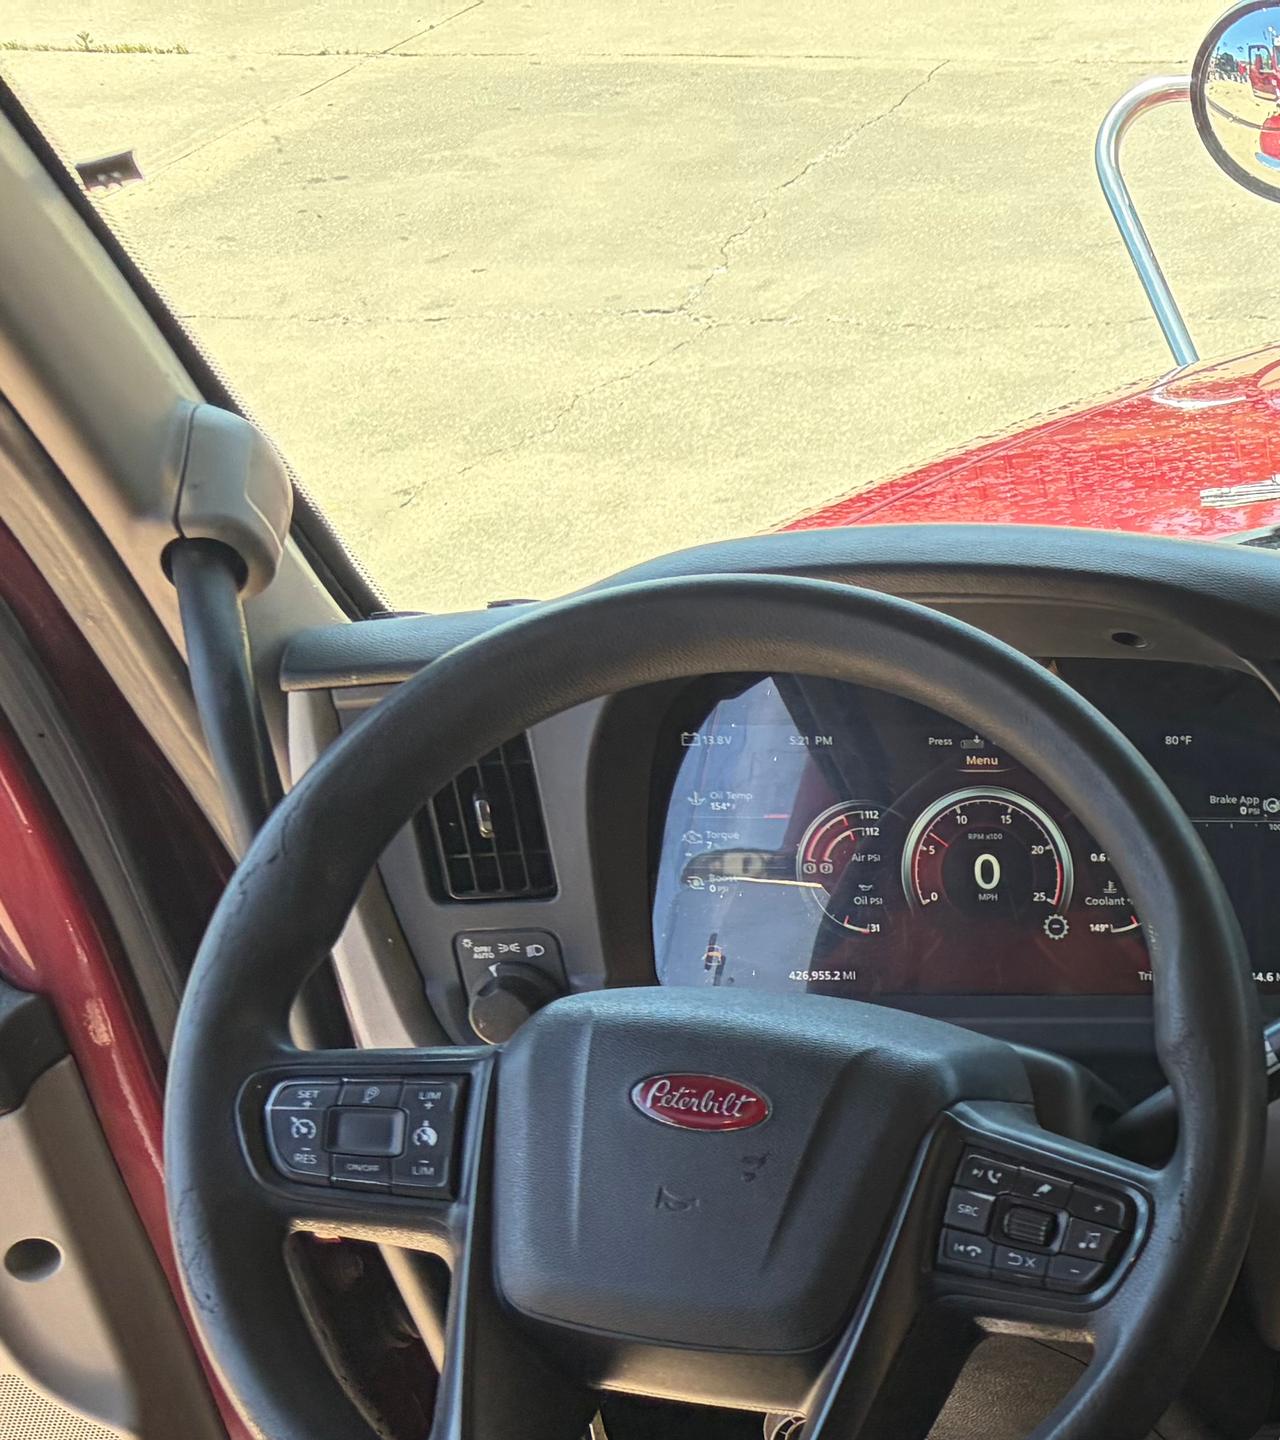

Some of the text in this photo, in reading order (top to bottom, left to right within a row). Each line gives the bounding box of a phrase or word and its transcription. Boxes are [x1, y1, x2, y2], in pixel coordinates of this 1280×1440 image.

[703, 736, 732, 745] 13.8V
[815, 736, 833, 745] PM
[928, 737, 953, 746] Press
[966, 755, 999, 765] Menu
[726, 792, 753, 802] Temp
[1209, 795, 1260, 806] Brake App
[864, 811, 879, 819] 112
[956, 815, 968, 824] 10
[1001, 815, 1012, 824] 15
[865, 827, 880, 836] 112
[706, 831, 740, 842] Torque
[929, 845, 936, 855] 5
[1031, 845, 1044, 855] 20
[851, 853, 866, 862] Air
[973, 853, 1001, 890] 0
[853, 896, 868, 905] Oil
[930, 892, 938, 901] 0
[978, 893, 998, 901] MPH
[1033, 892, 1046, 901] 25
[1084, 896, 1125, 906] Coolant
[297, 1089, 321, 1099] SET
[418, 1091, 442, 1100] LIM
[646, 1079, 757, 1118] Peterbilt
[293, 1153, 318, 1165] RES
[411, 1166, 435, 1176] LIM
[957, 1203, 980, 1217] SRC
